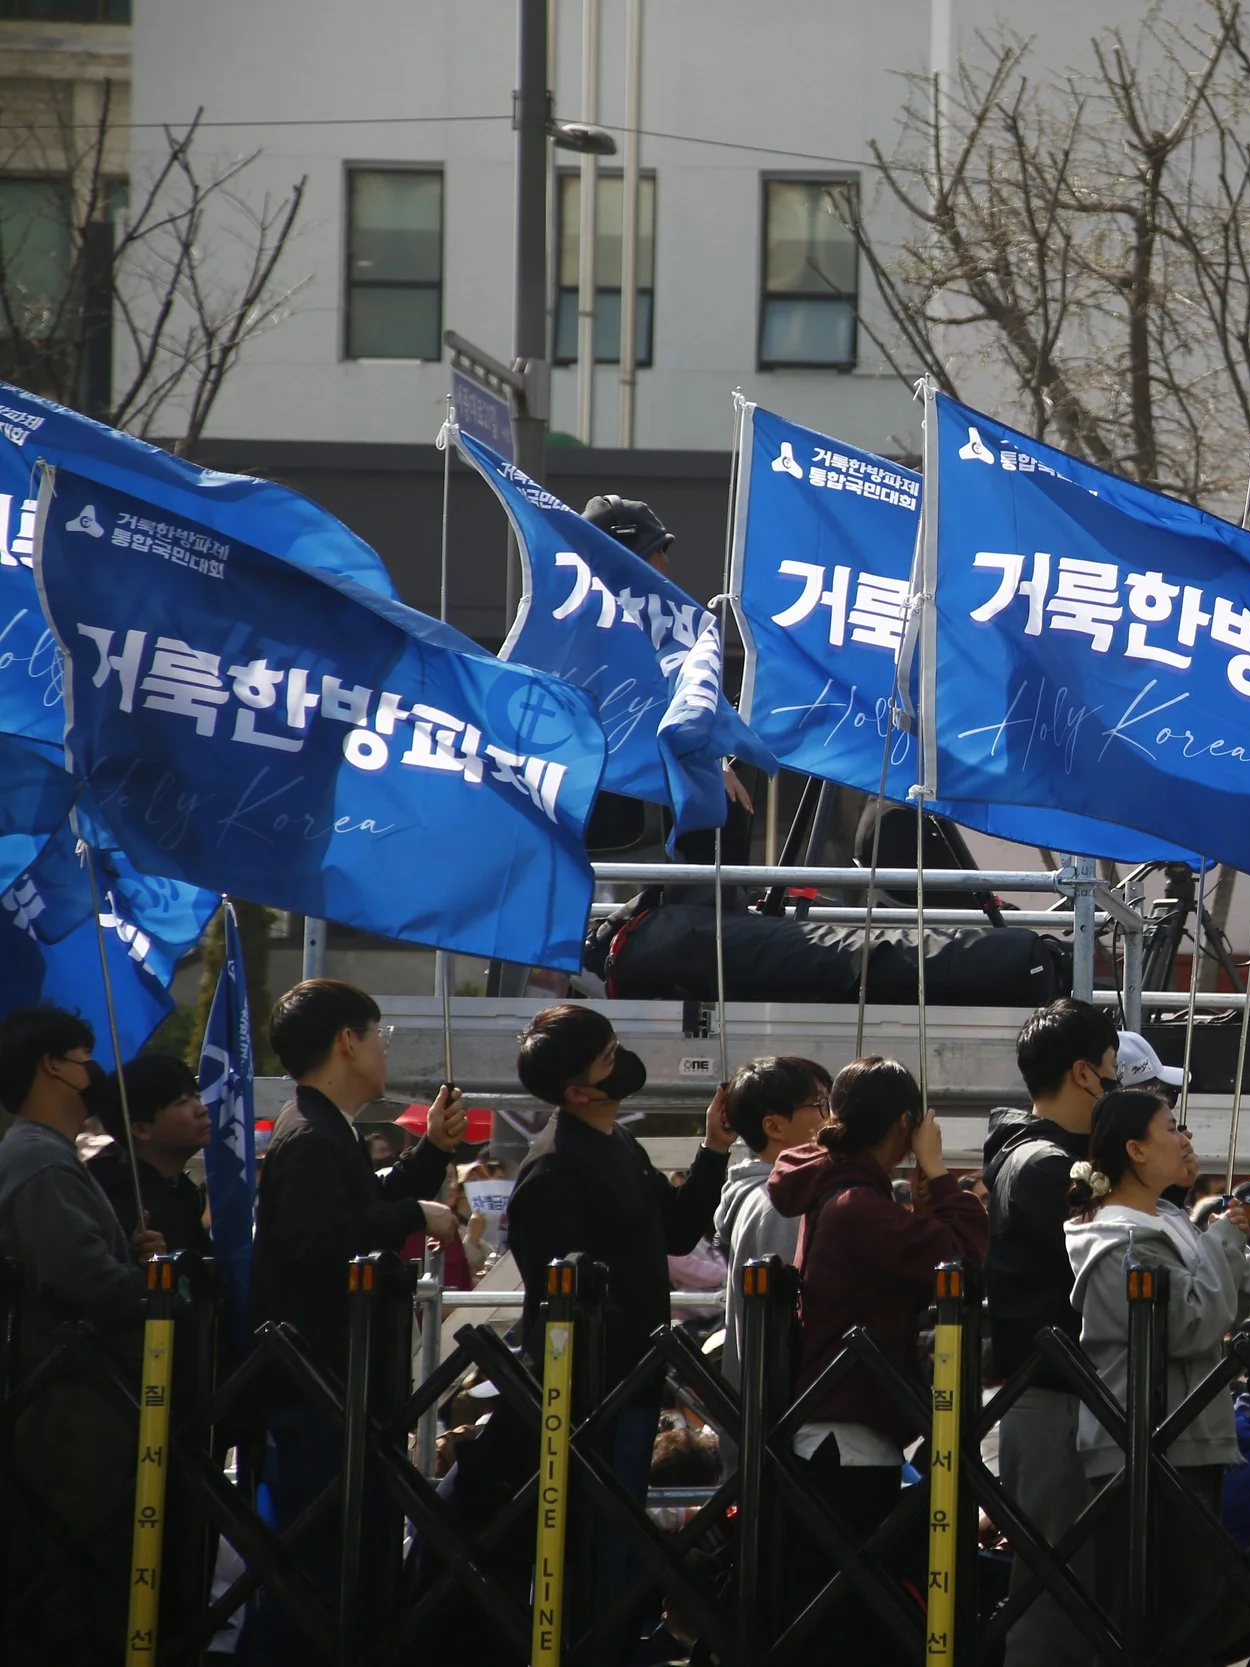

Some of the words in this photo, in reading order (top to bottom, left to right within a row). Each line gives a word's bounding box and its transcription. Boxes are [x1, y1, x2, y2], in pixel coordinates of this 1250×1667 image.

[808, 465, 918, 511] 통합국민대회
[812, 447, 919, 497] 거룩한방파제
[111, 528, 225, 580] 통합국민대회
[117, 512, 229, 561] 거룩한방파제
[77, 622, 567, 824] 거룩한방파제
[958, 679, 1104, 773] Holy
[217, 765, 395, 849] Korea
[542, 1387, 561, 1530] POLICE
[131, 1384, 166, 1652] 질서유지선
[926, 1389, 954, 1655] 질서유지선
[540, 1557, 556, 1652] LINE
